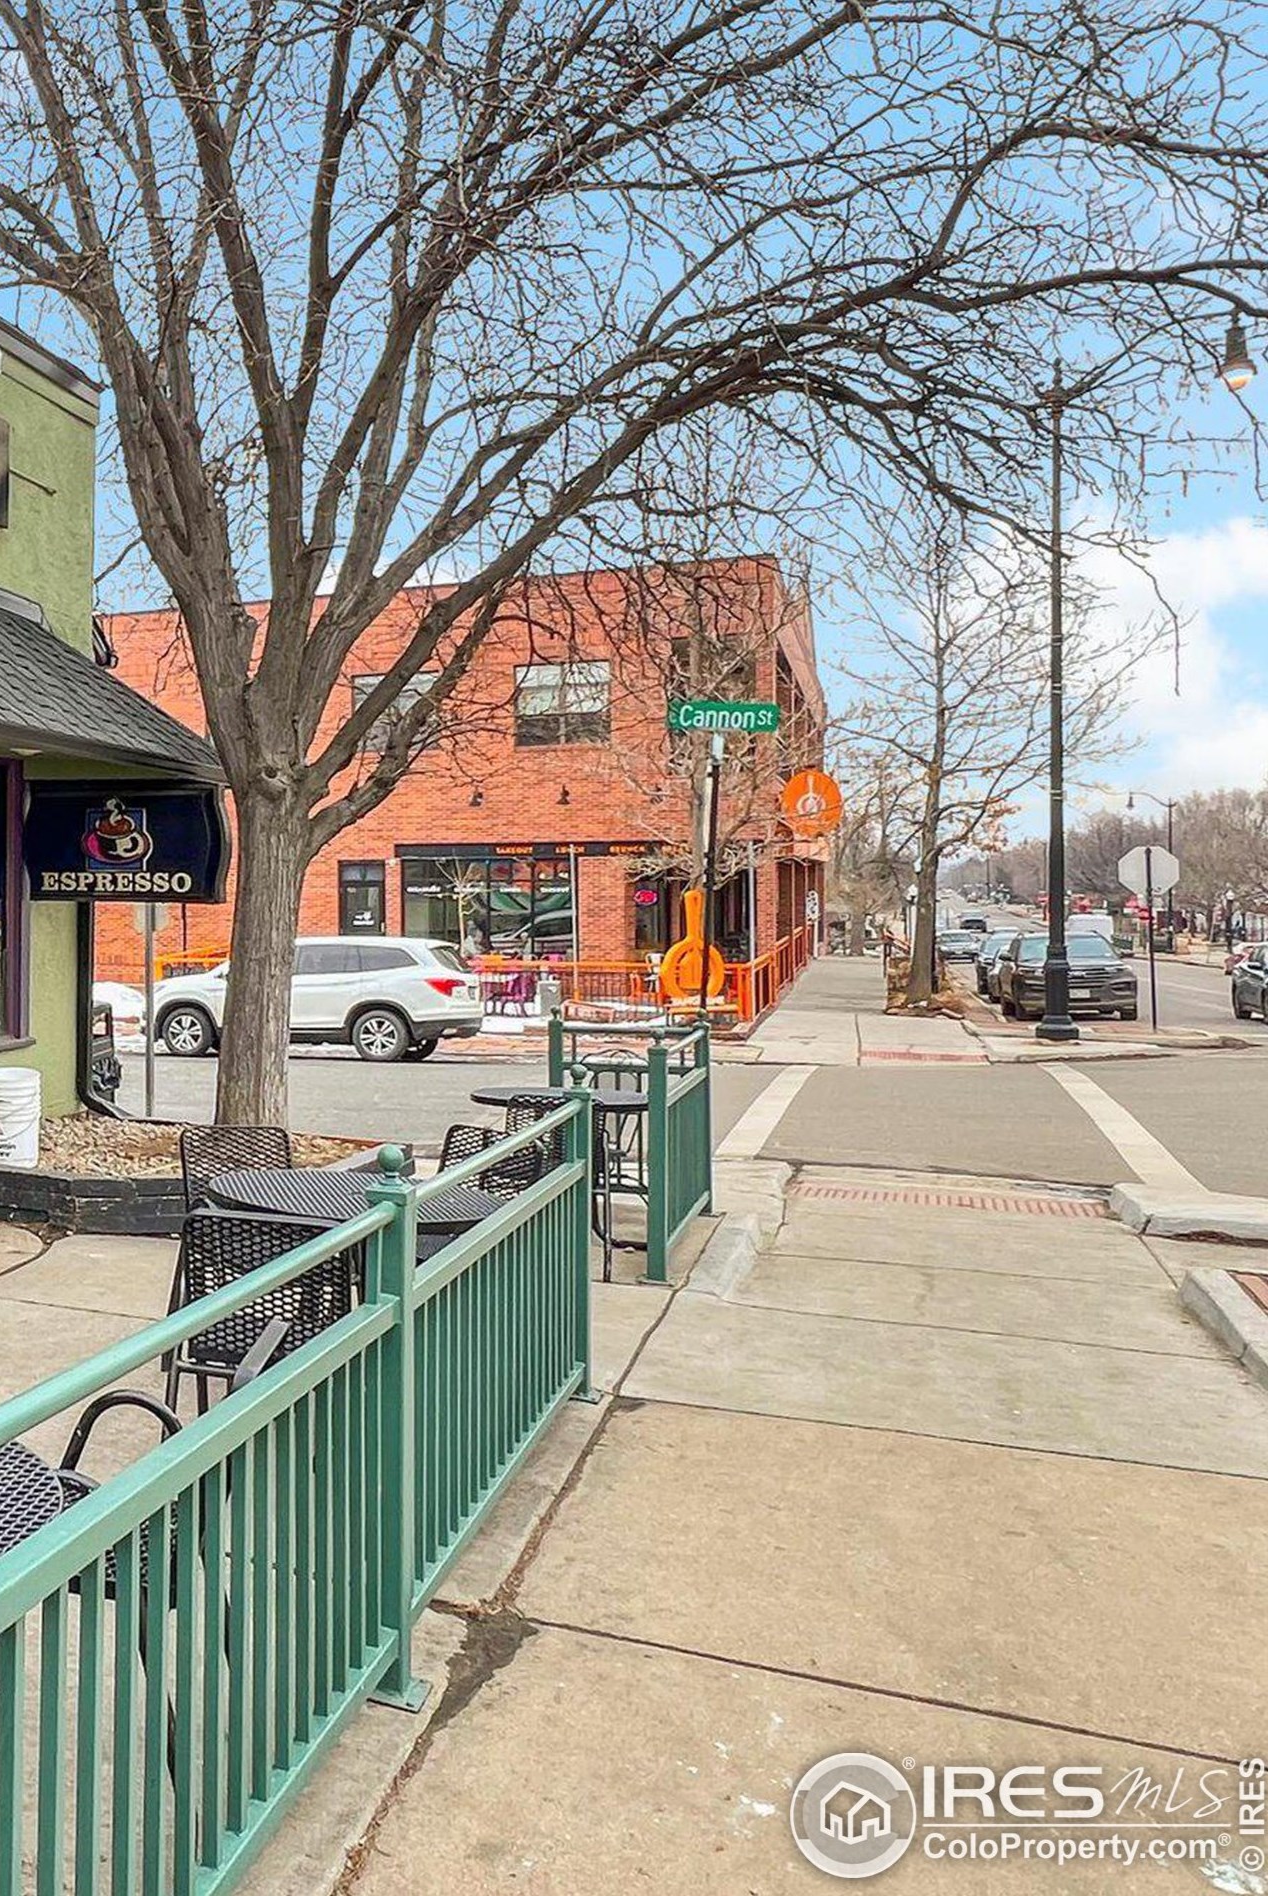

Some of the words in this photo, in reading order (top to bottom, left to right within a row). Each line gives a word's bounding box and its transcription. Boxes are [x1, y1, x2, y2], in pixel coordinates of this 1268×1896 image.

[679, 704, 756, 729] Cannon
[757, 709, 774, 726] St
[40, 871, 192, 893] ESPRESSO
